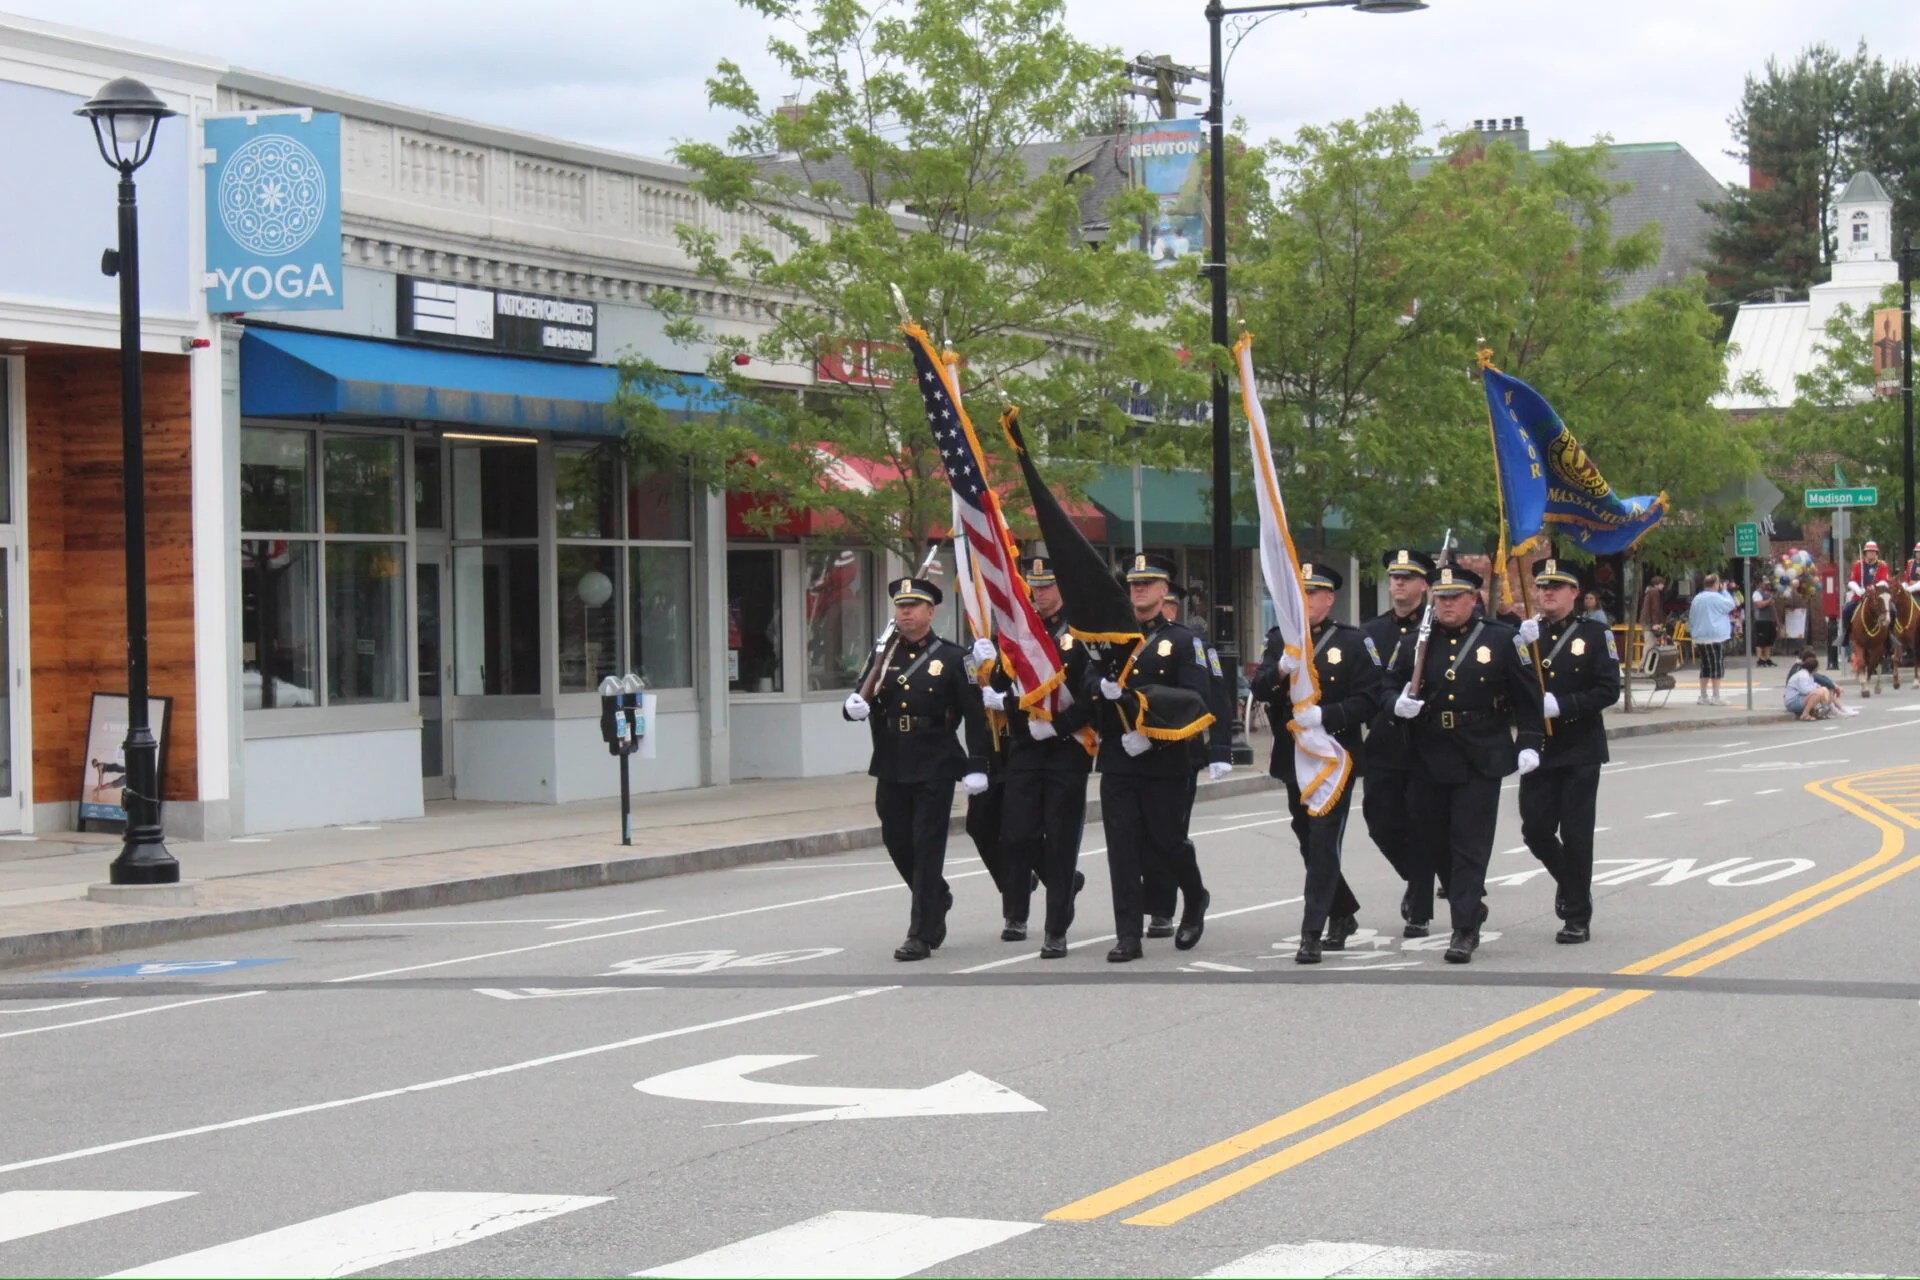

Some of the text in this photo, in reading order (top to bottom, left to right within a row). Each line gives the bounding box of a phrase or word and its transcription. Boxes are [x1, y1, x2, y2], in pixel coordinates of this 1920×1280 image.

[1130, 141, 1200, 158] NEWTON
[216, 263, 334, 300] YOGA
[497, 293, 594, 326] KITCHEN CABINETS
[1809, 493, 1853, 505] Madison
